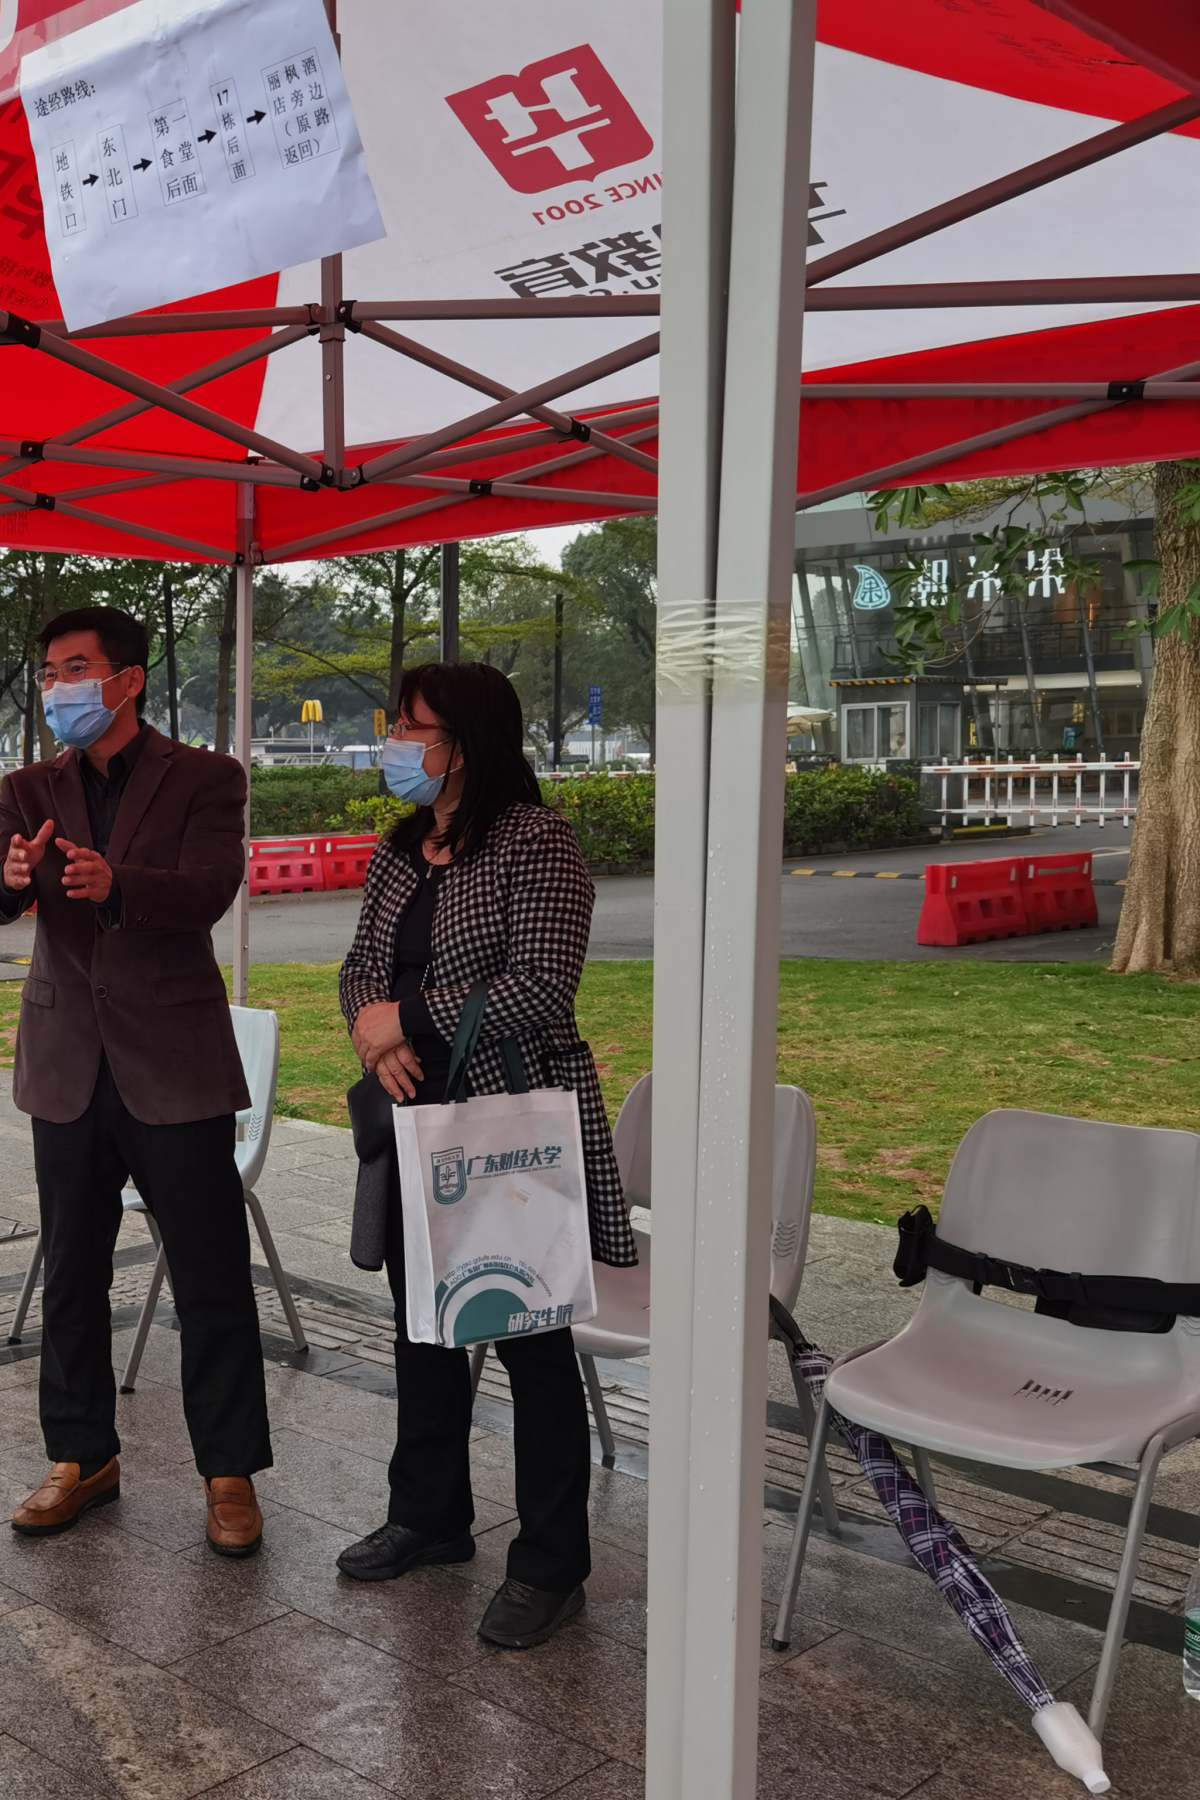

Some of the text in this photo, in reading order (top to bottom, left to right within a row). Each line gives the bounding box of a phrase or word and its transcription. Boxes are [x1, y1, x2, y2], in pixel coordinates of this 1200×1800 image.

[266, 54, 318, 92] 丽枫酒
[273, 80, 325, 115] 店旁边
[153, 112, 188, 139] 第一
[159, 141, 196, 168] 食堂
[55, 150, 78, 230] 地铁口
[101, 137, 129, 219] 东北门
[166, 173, 199, 201] 后面
[466, 1145, 562, 1176] 广东财经大学
[507, 1303, 574, 1333] 研究生院
